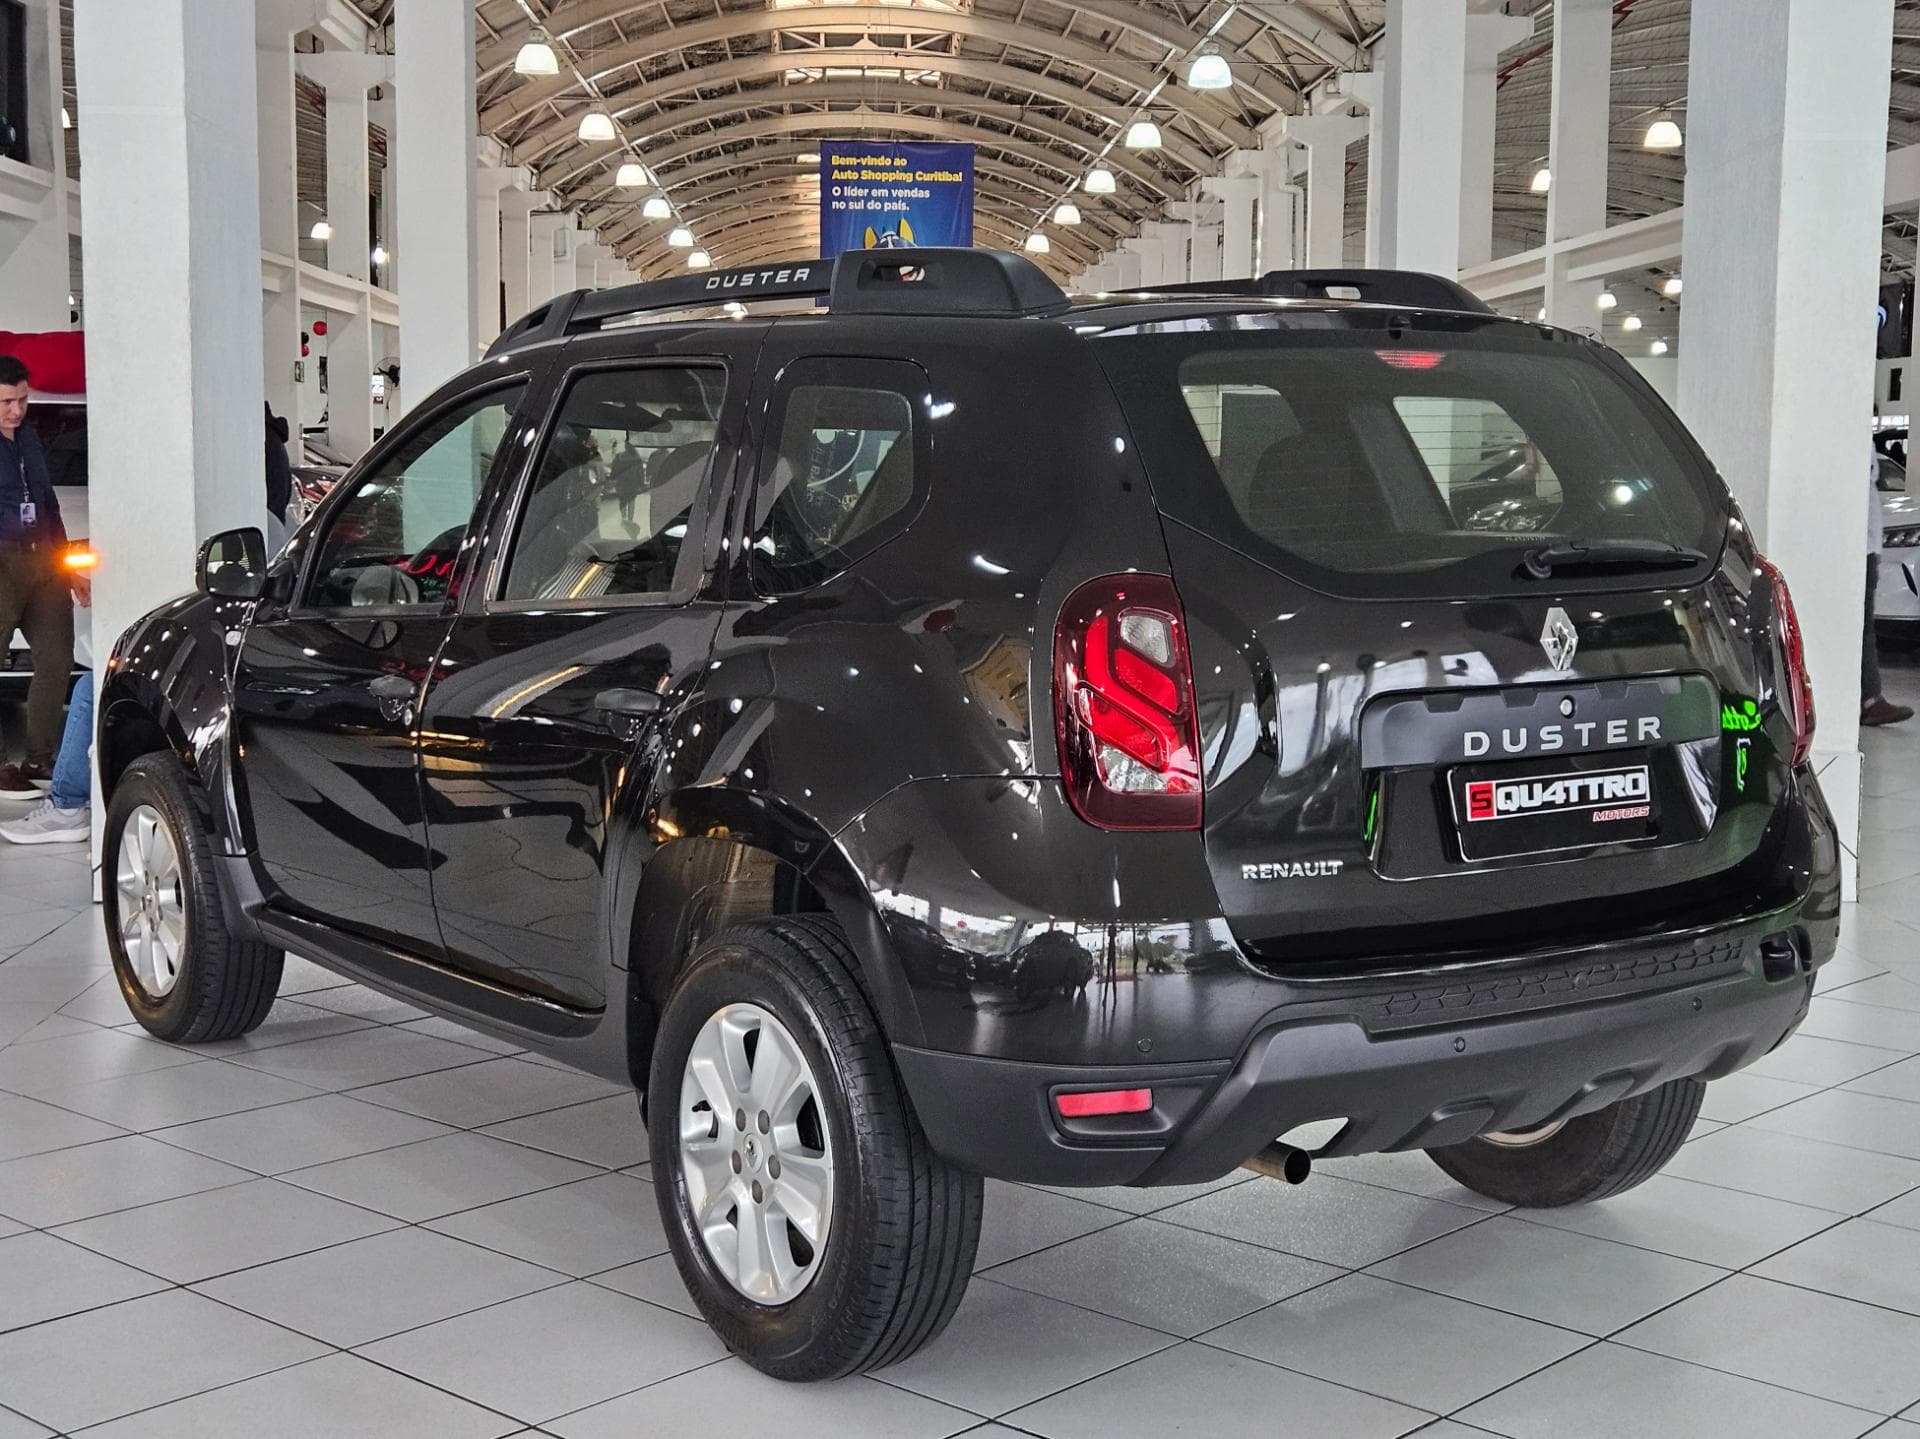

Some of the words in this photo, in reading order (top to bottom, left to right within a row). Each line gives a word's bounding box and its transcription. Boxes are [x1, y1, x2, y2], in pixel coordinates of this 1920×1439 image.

[831, 155, 892, 166] Bem-vindo
[893, 157, 907, 166] ao
[831, 170, 859, 180] Auto
[860, 170, 913, 182] Shopping
[915, 171, 963, 182] Curitiba!
[832, 187, 842, 196] O
[844, 186, 869, 197] líder
[871, 189, 889, 197] em
[891, 187, 930, 198] vendas
[832, 201, 846, 209] no
[848, 199, 865, 209] sul
[866, 200, 882, 210] do
[884, 200, 910, 212] país.
[705, 267, 811, 290] DUSTER
[1463, 716, 1662, 757] DUSTER
[1593, 805, 1650, 822] MOTORS
[1241, 859, 1344, 880] RENAULT
